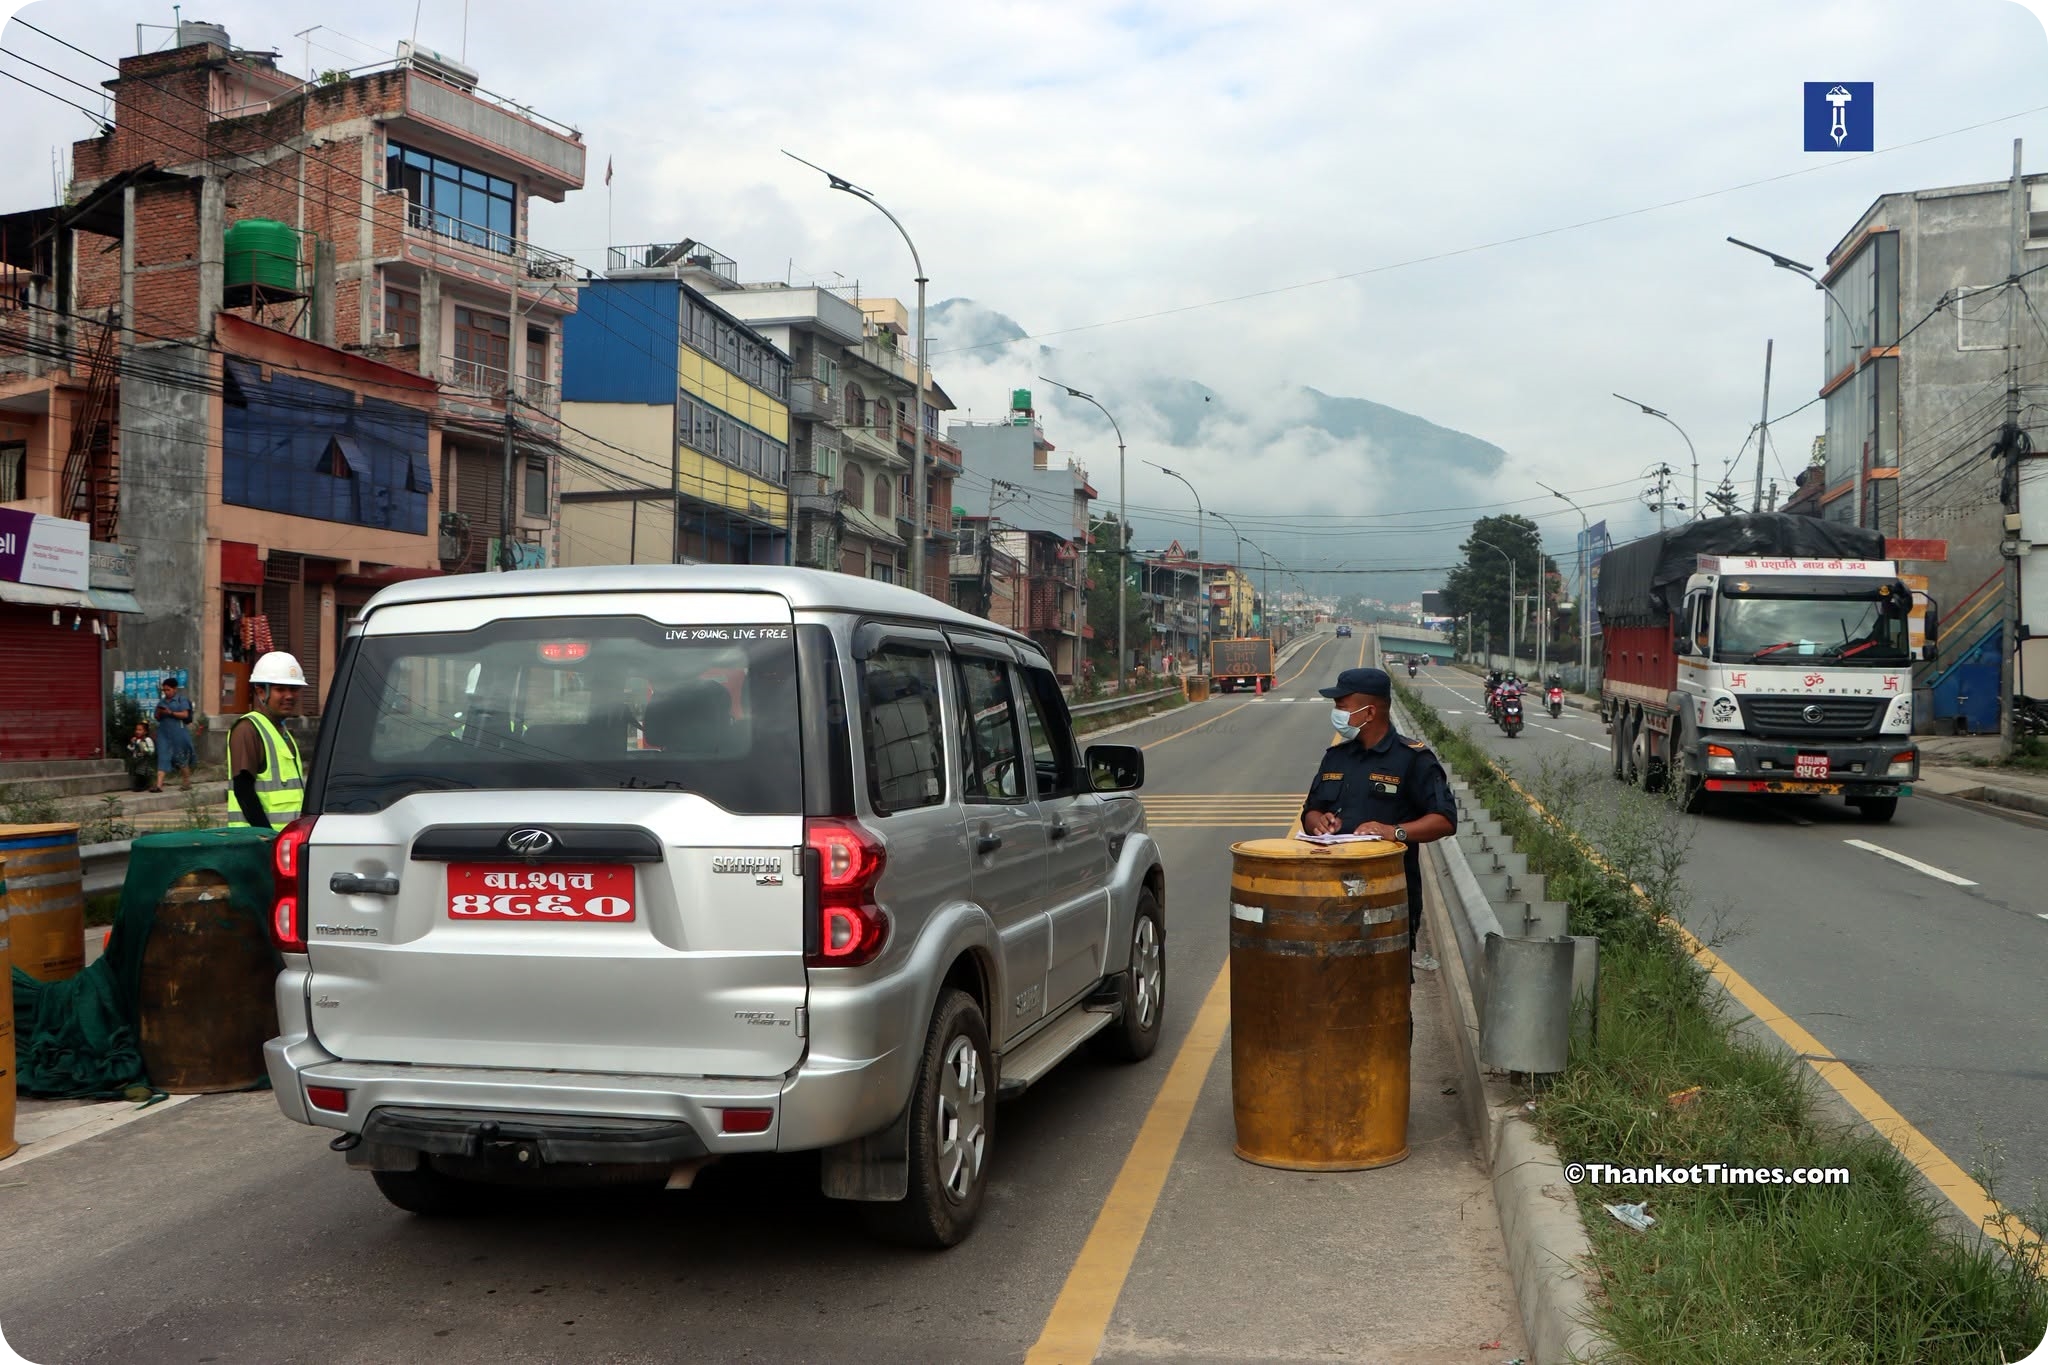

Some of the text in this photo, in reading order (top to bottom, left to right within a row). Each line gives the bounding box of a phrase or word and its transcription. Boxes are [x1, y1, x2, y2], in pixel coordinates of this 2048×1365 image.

[1761, 560, 1796, 570] पशुपति
[666, 630, 688, 640] LIVE
[733, 629, 756, 639] LIVE
[759, 629, 788, 639] FREE
[1226, 652, 1256, 661] LIMIT
[452, 894, 630, 917] ४८६०
